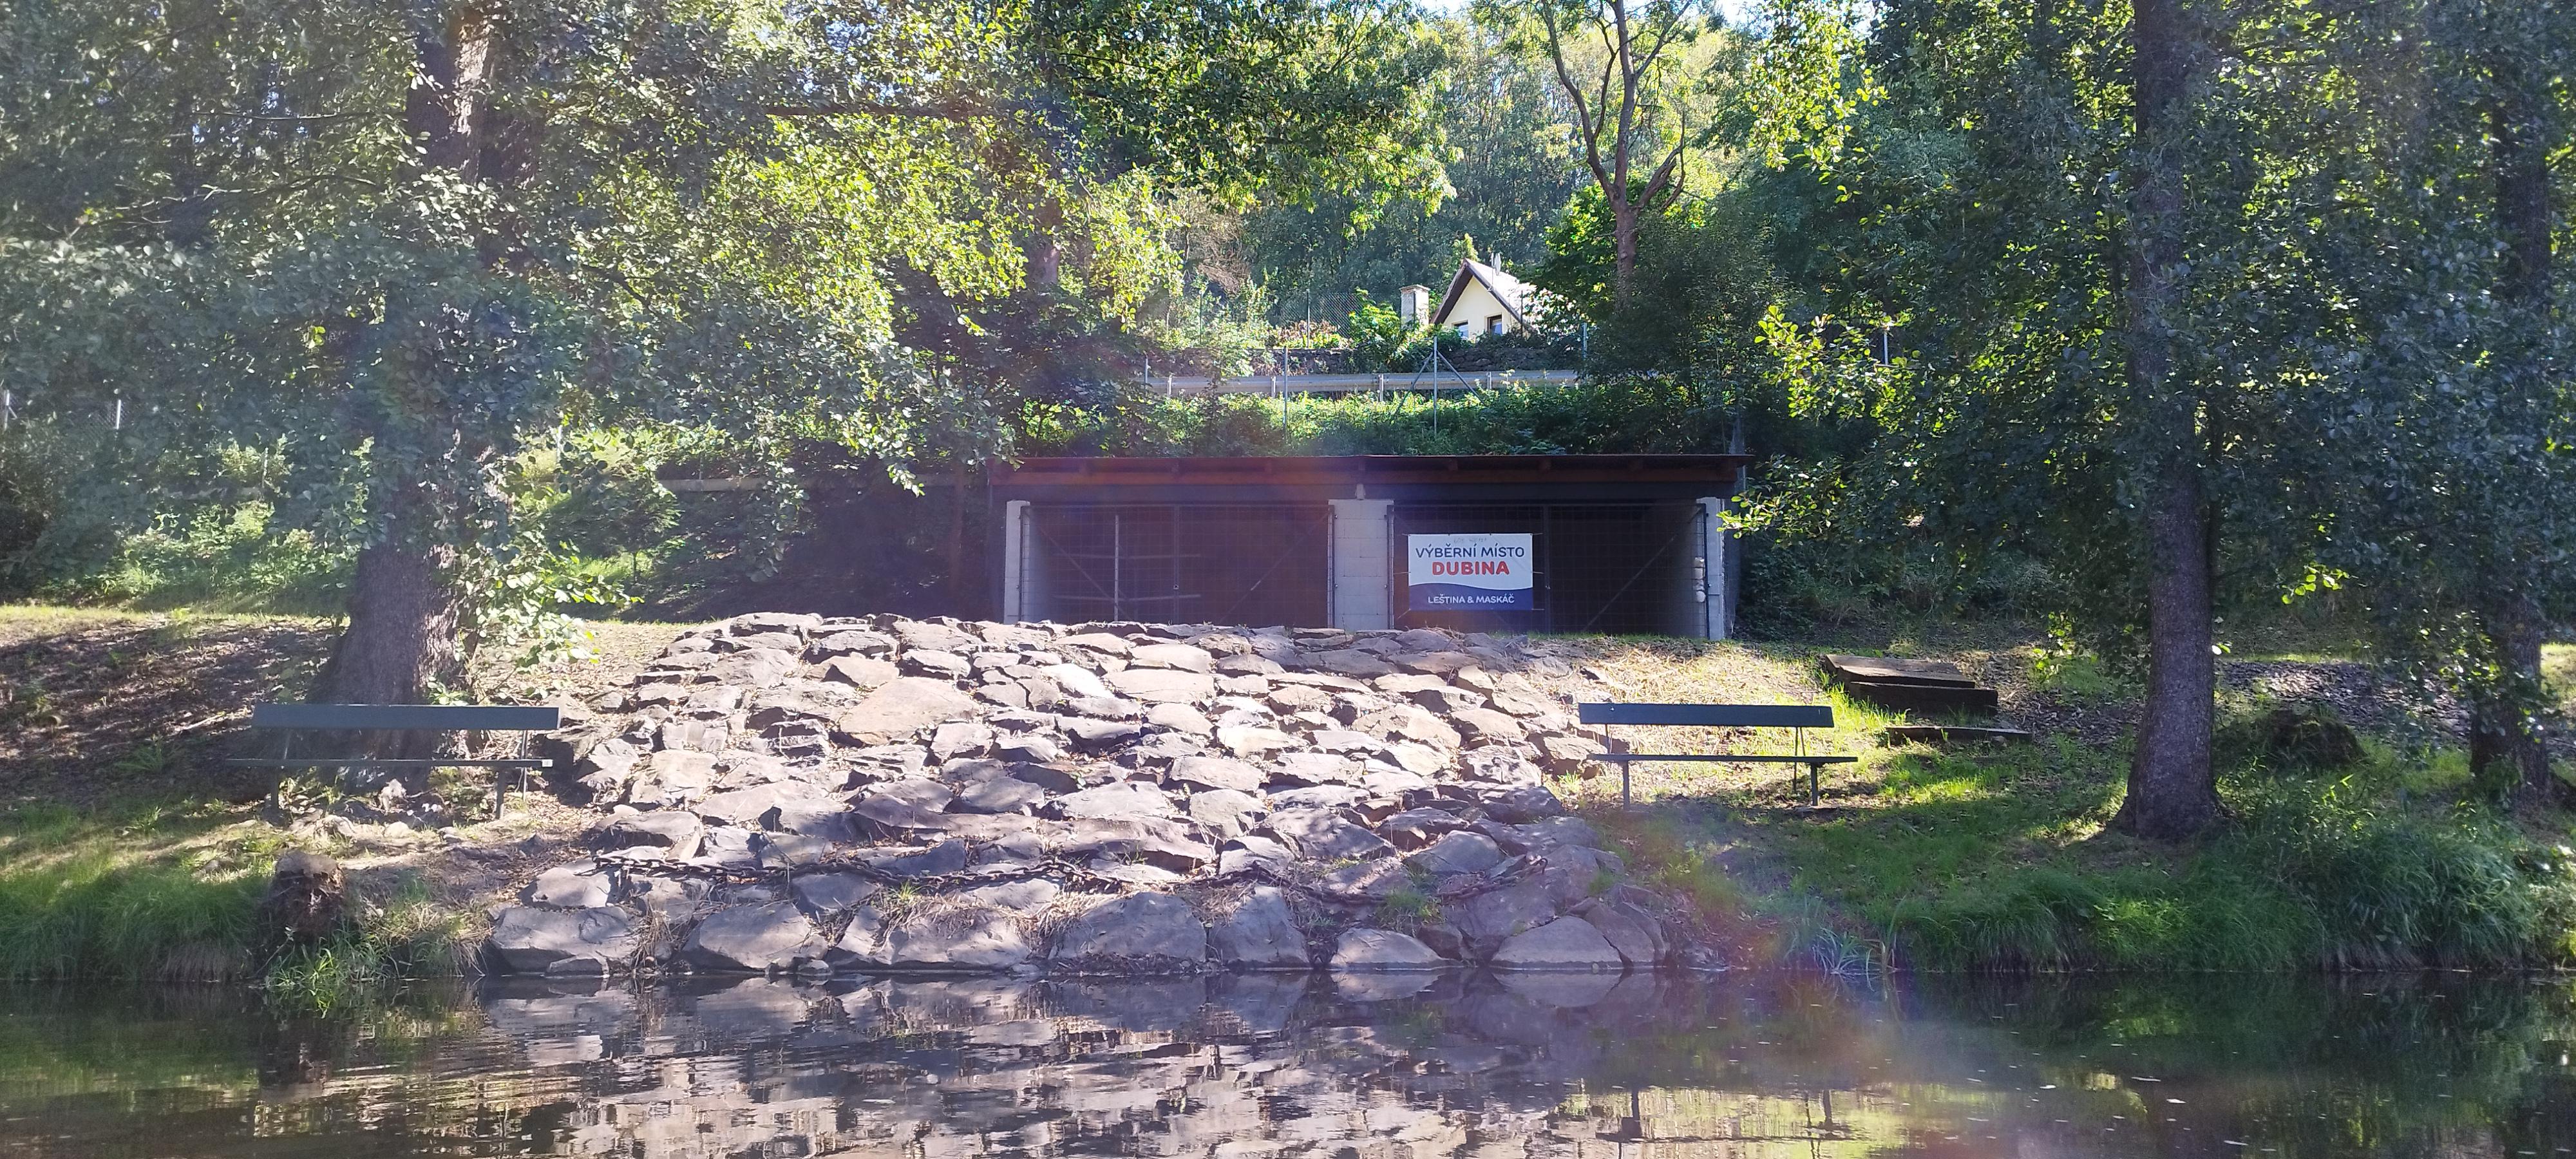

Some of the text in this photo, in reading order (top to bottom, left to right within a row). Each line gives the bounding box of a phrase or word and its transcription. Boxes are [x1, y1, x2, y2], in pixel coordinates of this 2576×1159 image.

[1416, 543, 1525, 558] VÝBĚRNÍ MÍSTO
[1432, 561, 1510, 576] DUBINA
[1428, 593, 1464, 604] LEŠTINA
[1475, 593, 1515, 604] MASKÁČ
